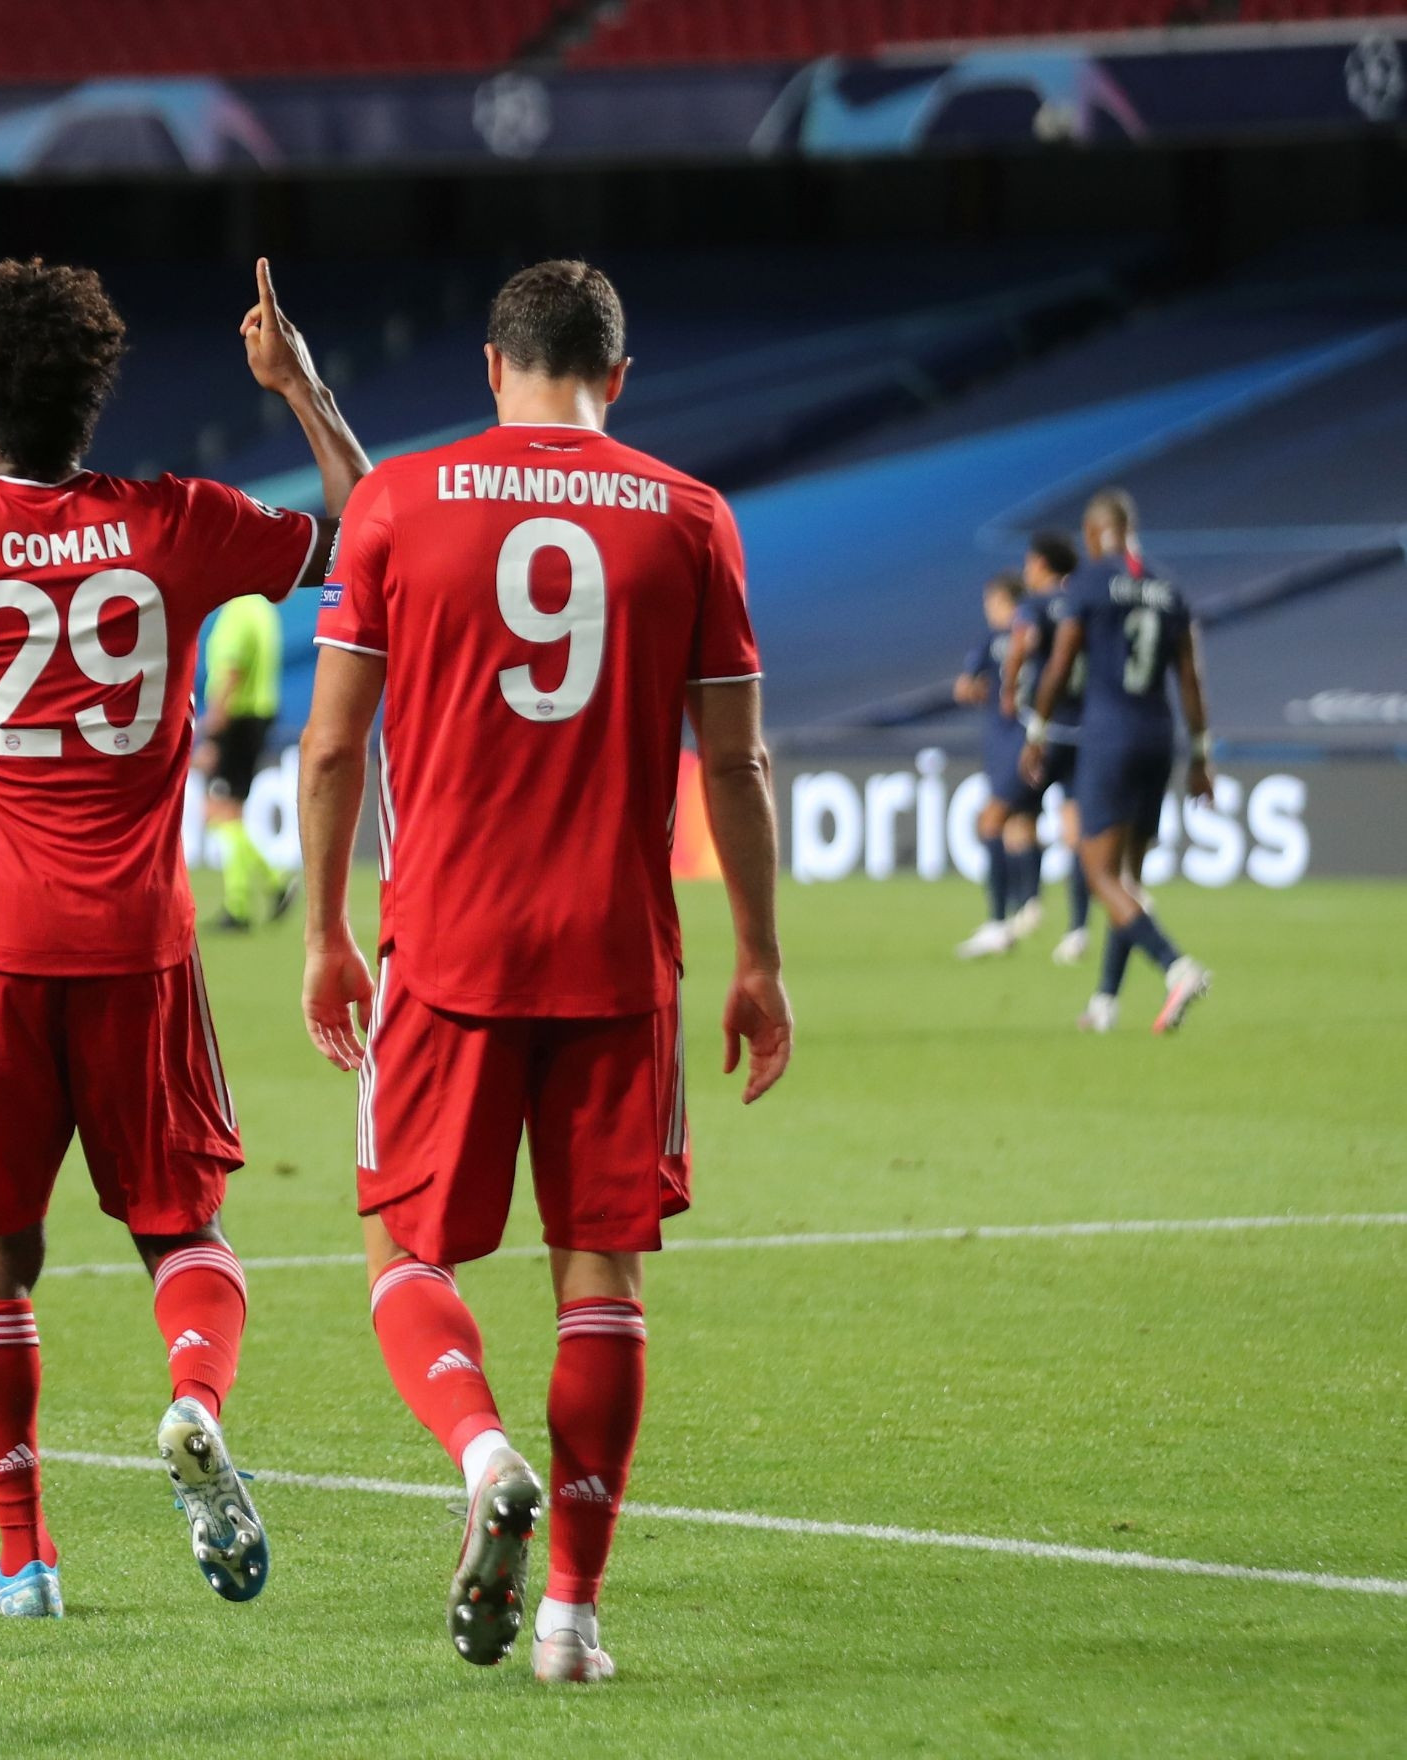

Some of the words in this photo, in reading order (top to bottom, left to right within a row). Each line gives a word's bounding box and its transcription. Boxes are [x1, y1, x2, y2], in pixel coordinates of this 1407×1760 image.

[438, 464, 669, 514] LEWANDOWSKI
[2, 521, 131, 568] COMAN
[496, 517, 606, 722] 9
[1123, 606, 1160, 696] 3
